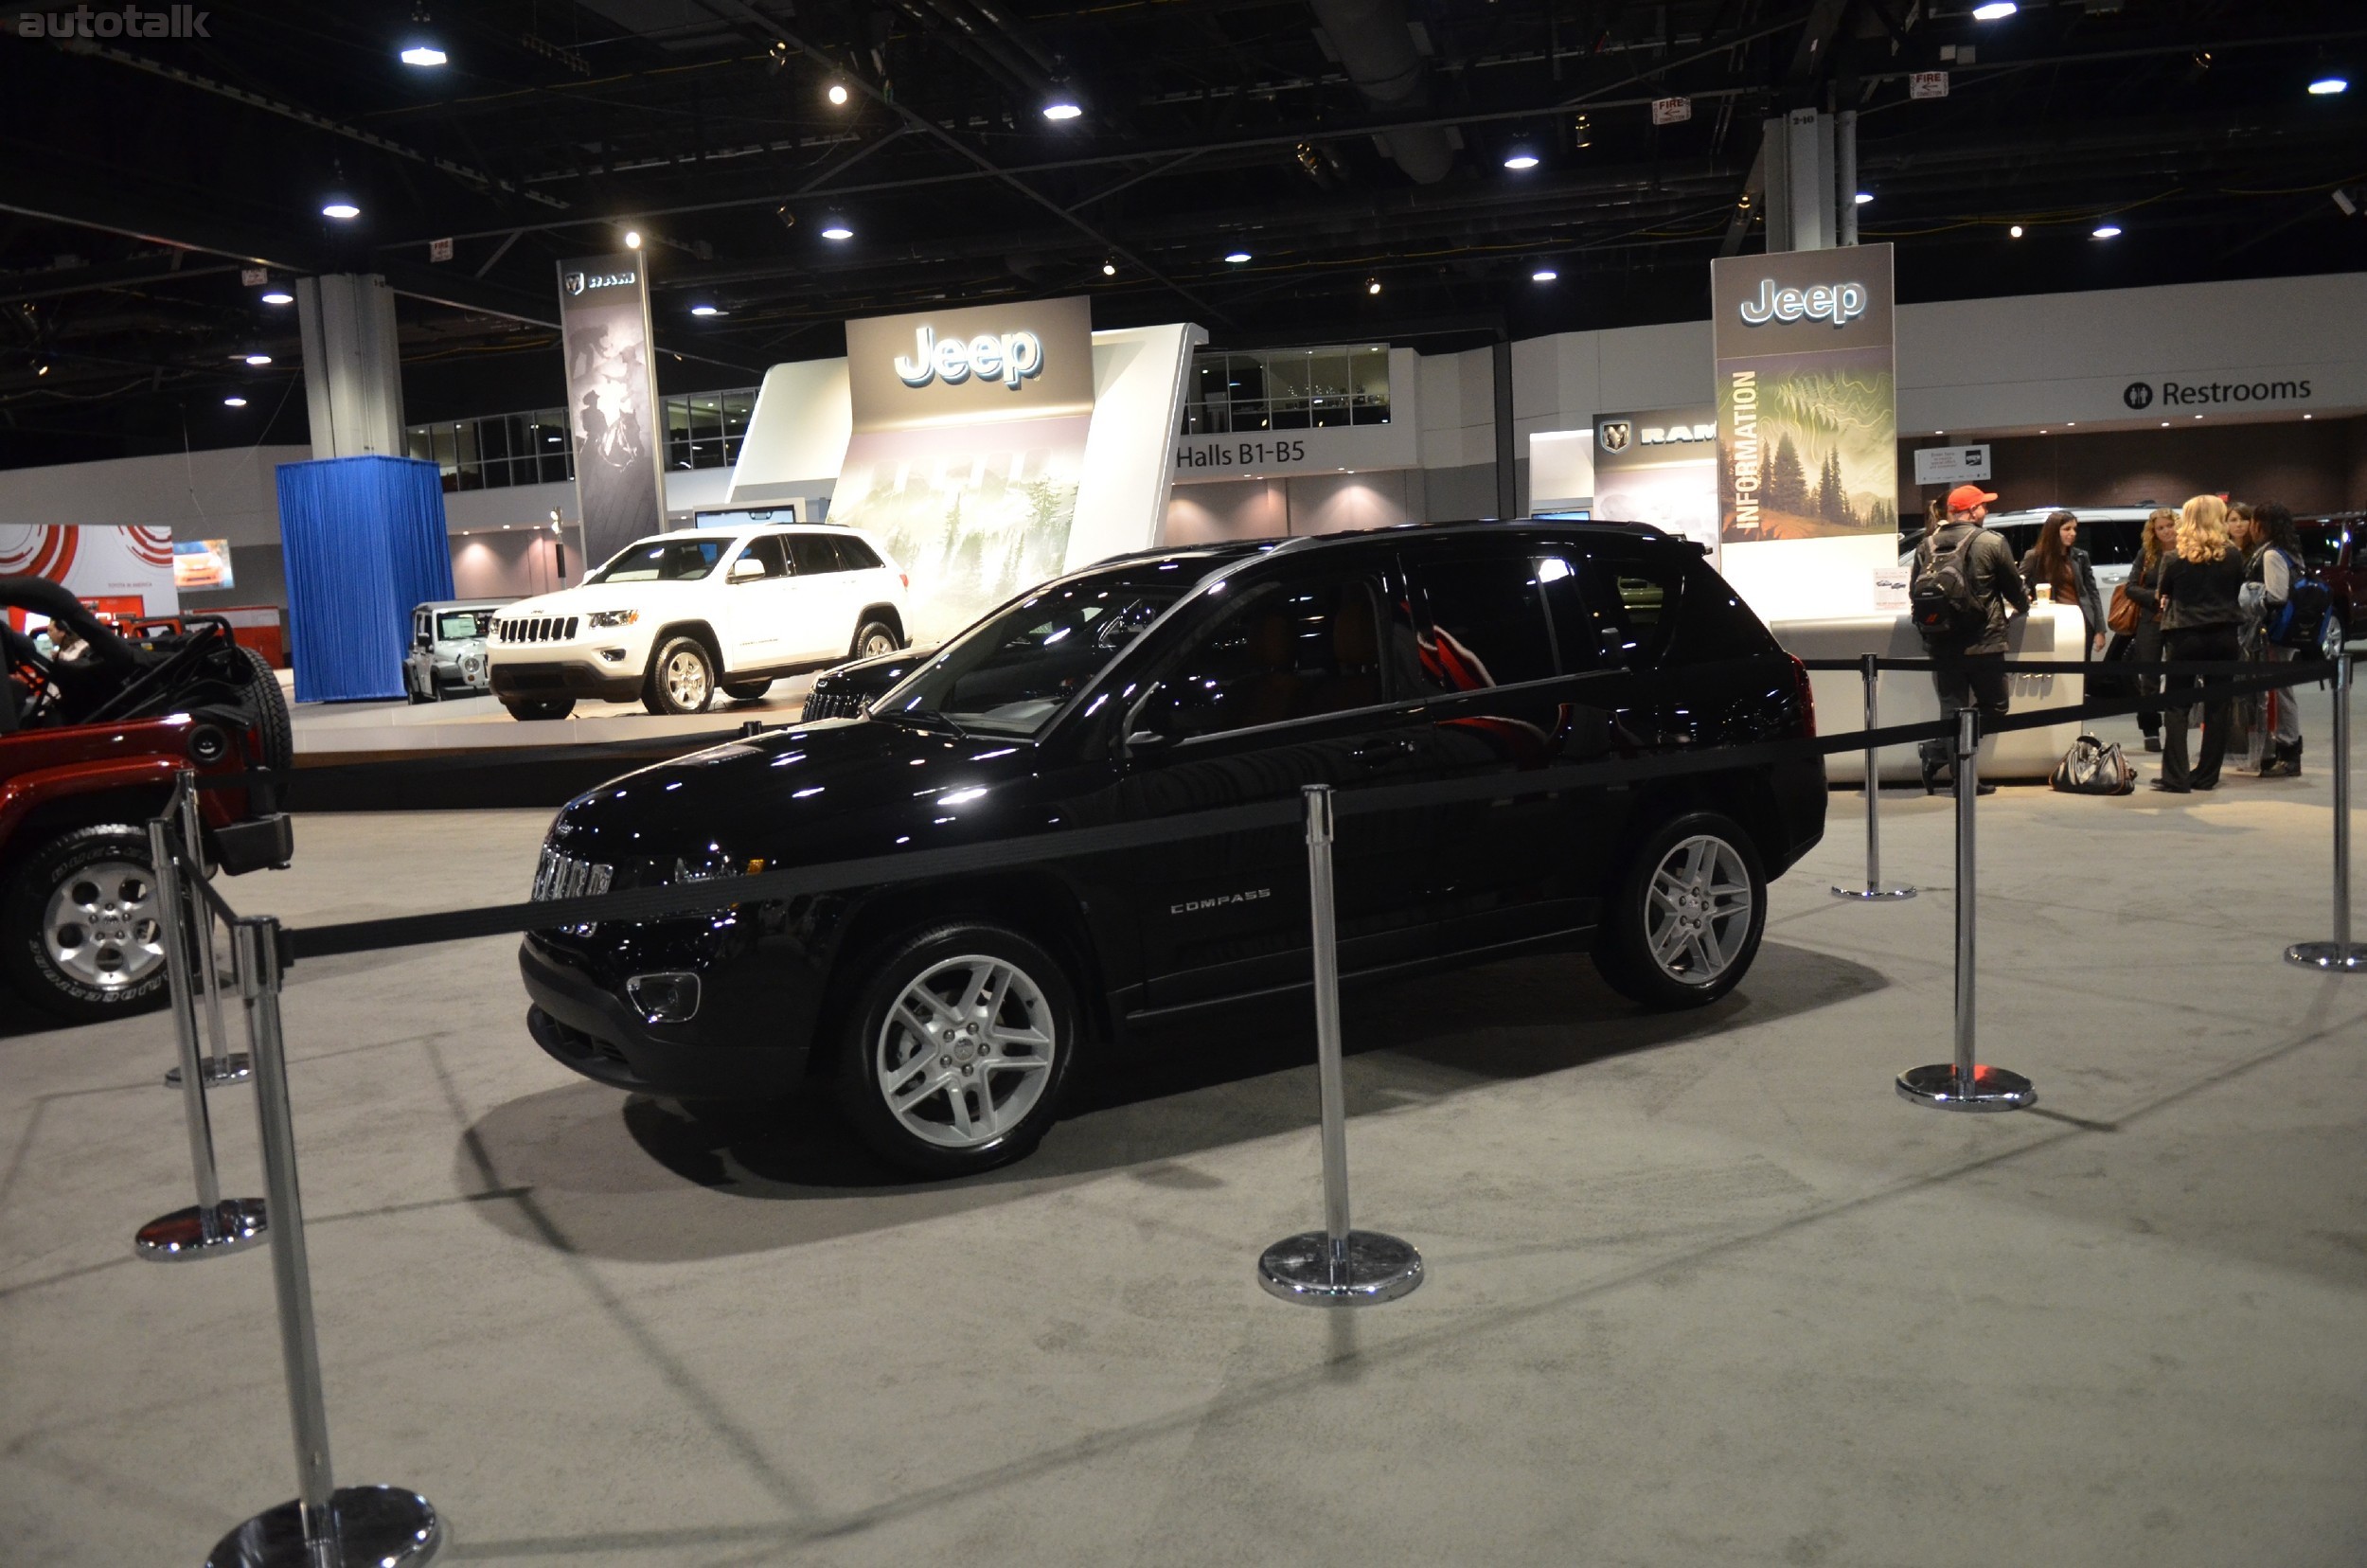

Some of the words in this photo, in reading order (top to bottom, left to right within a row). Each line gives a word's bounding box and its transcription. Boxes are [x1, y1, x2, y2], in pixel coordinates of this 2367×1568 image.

[1916, 73, 1941, 83] FIRE
[1659, 98, 1683, 110] FIRE
[589, 273, 635, 288] RAM
[1740, 278, 1867, 327] Jeep
[894, 327, 1043, 389] Jeep
[2162, 380, 2311, 405] Restrooms
[1176, 444, 1233, 468] Halls
[1238, 440, 1305, 465] B1-B5
[1733, 371, 1759, 529] INFORMATION
[1170, 888, 1271, 914] COMPASS
